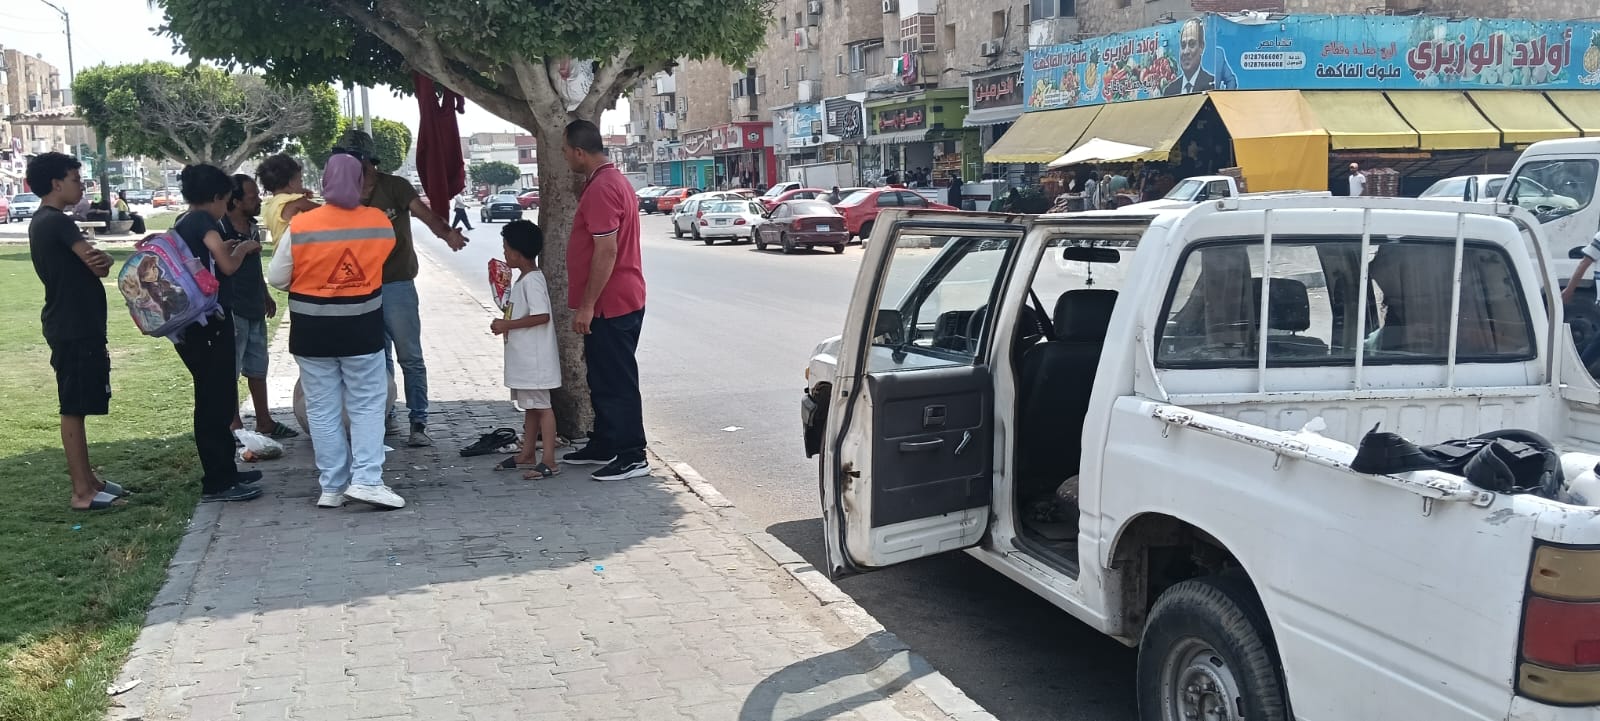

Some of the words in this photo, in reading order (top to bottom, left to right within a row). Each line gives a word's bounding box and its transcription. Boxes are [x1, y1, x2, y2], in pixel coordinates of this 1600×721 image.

[1102, 38, 1136, 66] الوزيري
[1136, 32, 1160, 55] أولاد
[1256, 39, 1274, 50] مصر
[1512, 26, 1573, 75] أولاد
[1032, 53, 1064, 71] الفاكهة
[1064, 49, 1087, 67] ملوك
[1407, 33, 1504, 80] الوزيري
[1315, 62, 1363, 78] الفاكهة
[1366, 63, 1401, 81] ملوك
[976, 76, 1014, 102] الحرمين
